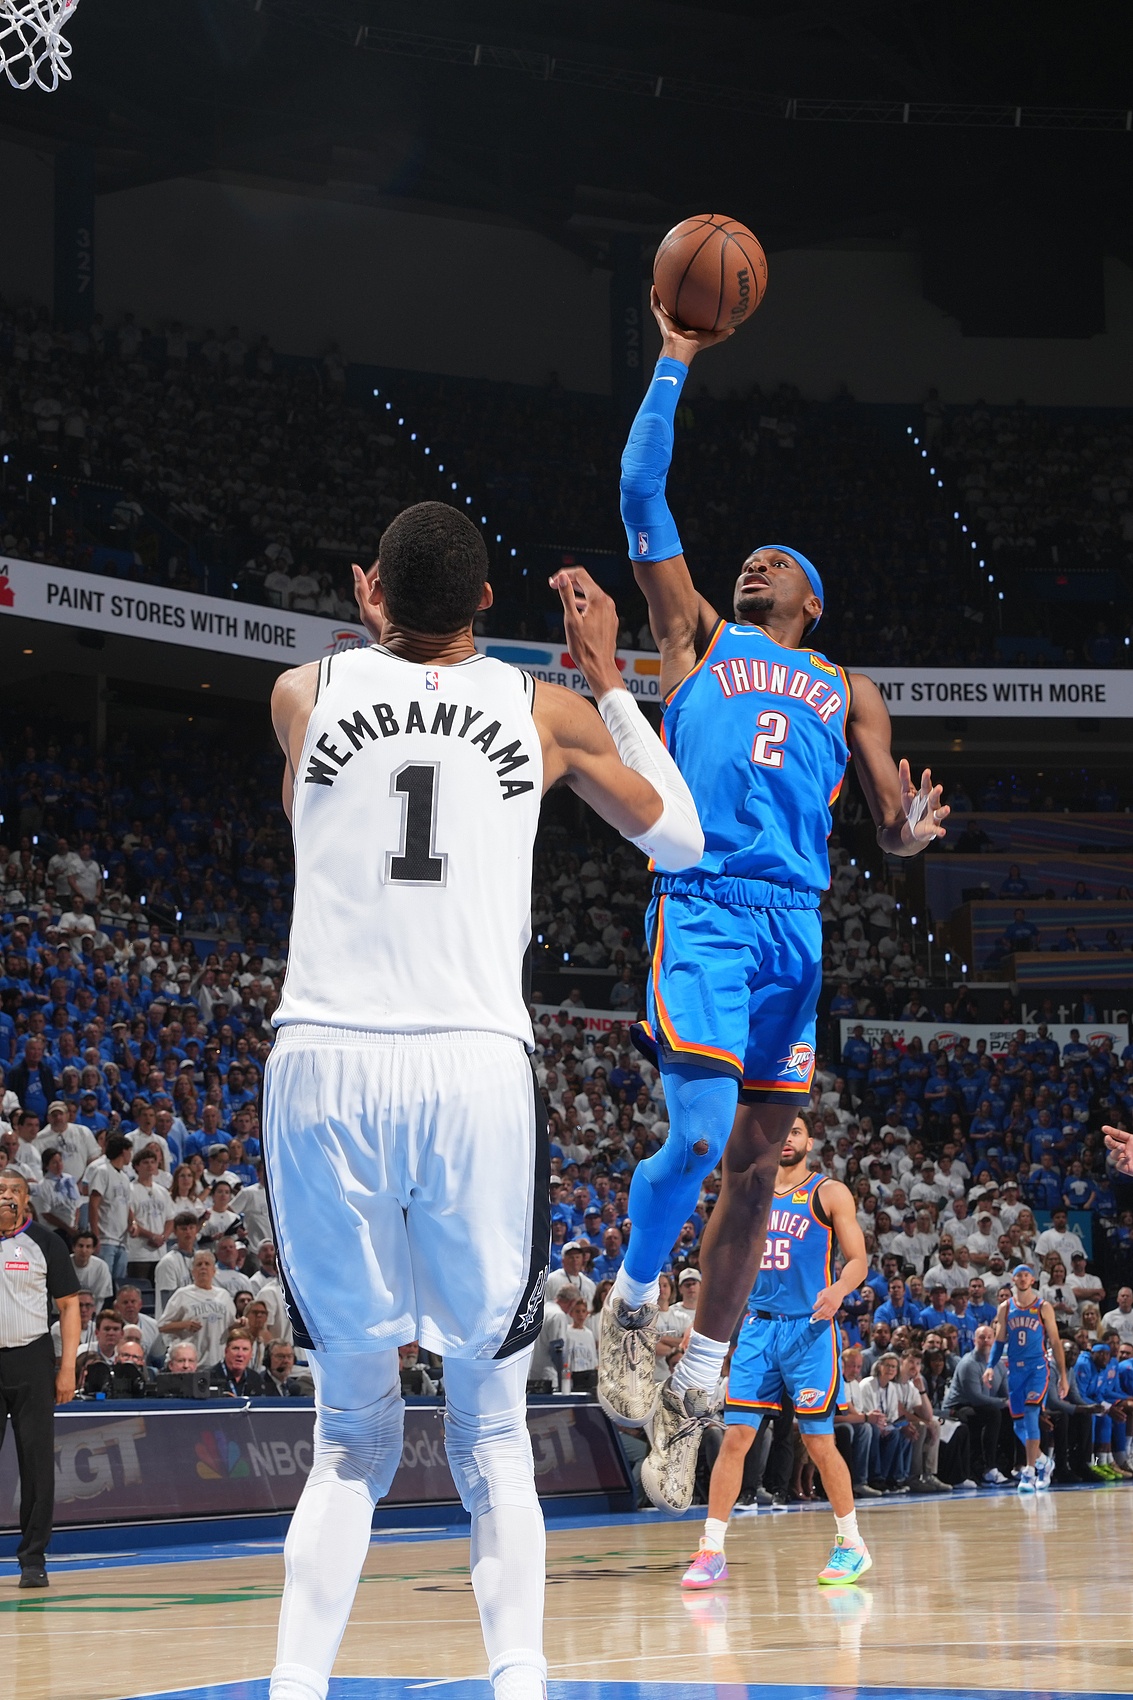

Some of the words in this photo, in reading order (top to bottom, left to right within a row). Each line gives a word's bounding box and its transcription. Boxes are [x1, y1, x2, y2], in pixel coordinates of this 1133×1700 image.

[47, 583, 104, 613] PAINT
[111, 595, 186, 629] STORES
[190, 609, 238, 638] WITH
[244, 619, 297, 649] MORE
[623, 678, 660, 696] OLO
[710, 658, 842, 724] THUNDER
[874, 681, 905, 701] NT
[911, 682, 988, 701] STORES
[993, 683, 1043, 702] WITH
[1049, 684, 1107, 703] MORE
[304, 701, 534, 801] WEMBANYAMA
[751, 709, 790, 769] 2
[384, 759, 449, 888] 1
[767, 1209, 810, 1241] NDER
[760, 1238, 792, 1270] 25
[1008, 1315, 1041, 1332] THUNDER
[1018, 1330, 1027, 1347] 9
[399, 1430, 447, 1470] ock
[531, 1409, 576, 1475] GT
